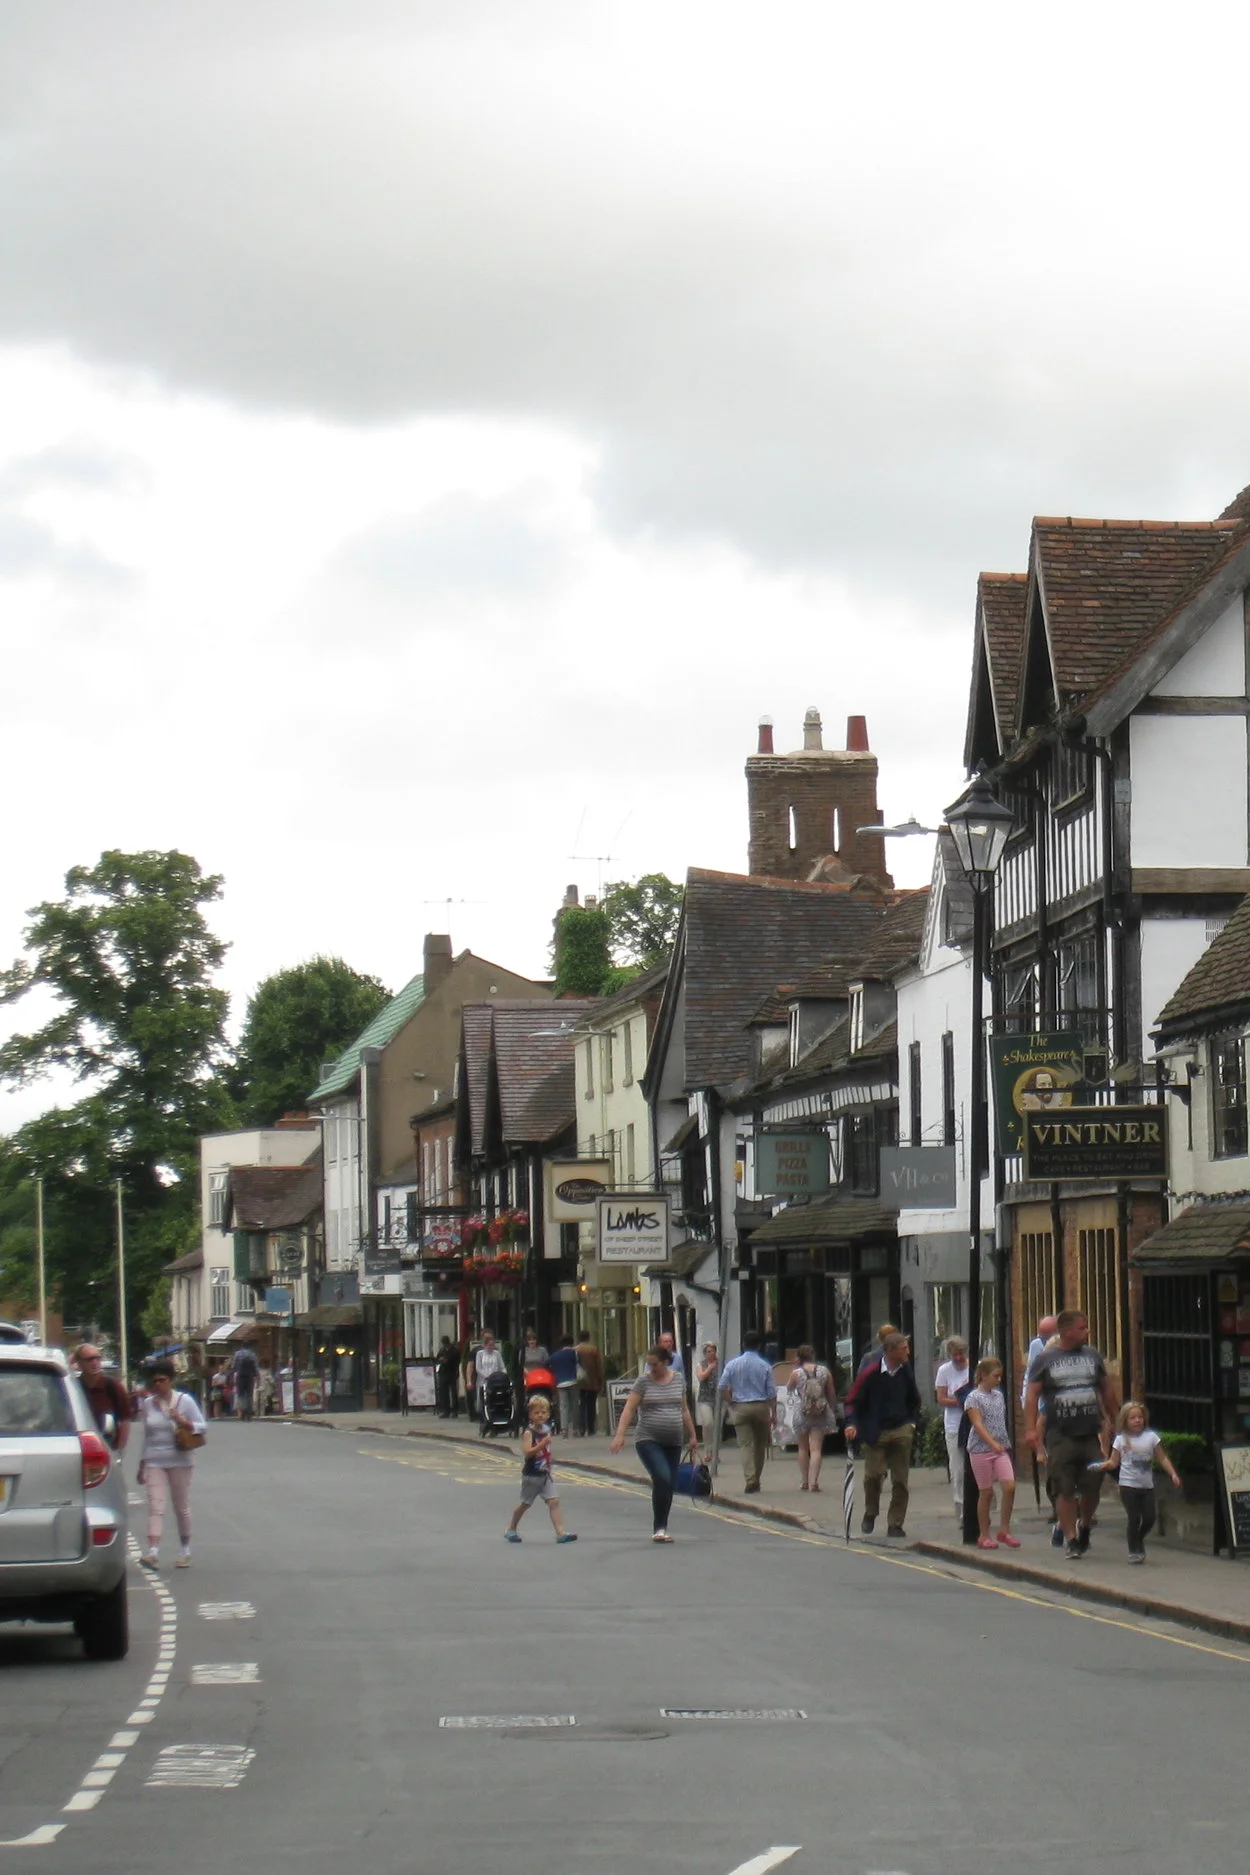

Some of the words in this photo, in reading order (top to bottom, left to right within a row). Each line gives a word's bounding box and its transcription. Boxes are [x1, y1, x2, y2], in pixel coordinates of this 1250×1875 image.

[1028, 1034, 1048, 1047] The
[1009, 1049, 1070, 1063] Shakespeare
[1032, 1121, 1162, 1145] VINTNER
[778, 1157, 807, 1170] PIZZA
[776, 1173, 809, 1187] PASTA
[606, 1206, 660, 1232] Lambs
[606, 1247, 662, 1255] RESTAURANT
